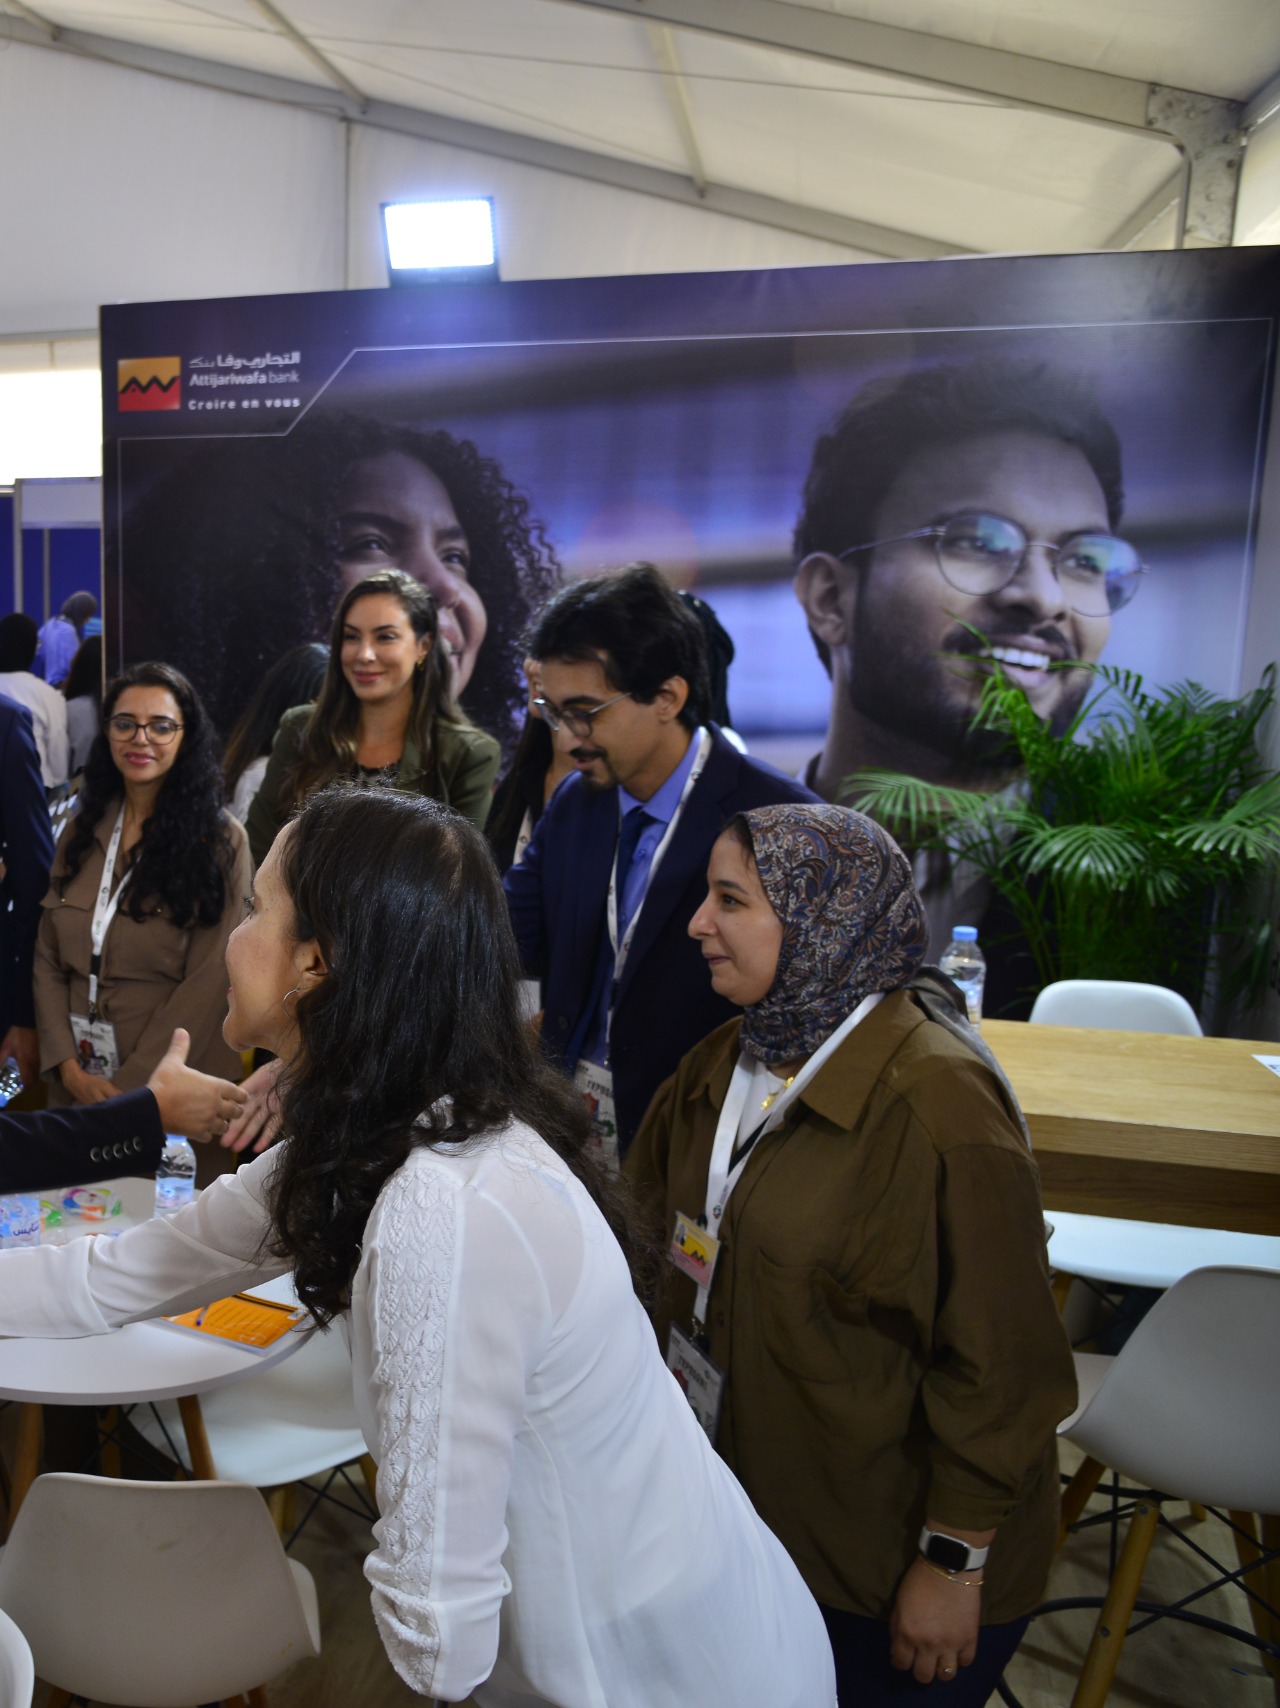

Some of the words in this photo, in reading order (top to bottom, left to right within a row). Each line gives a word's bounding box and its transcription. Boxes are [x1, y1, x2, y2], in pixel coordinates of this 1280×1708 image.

[189, 370, 267, 388] Attijariwafa
[268, 370, 299, 383] bank
[188, 398, 236, 410] Croire
[241, 398, 260, 409] en
[264, 397, 300, 408] vous
